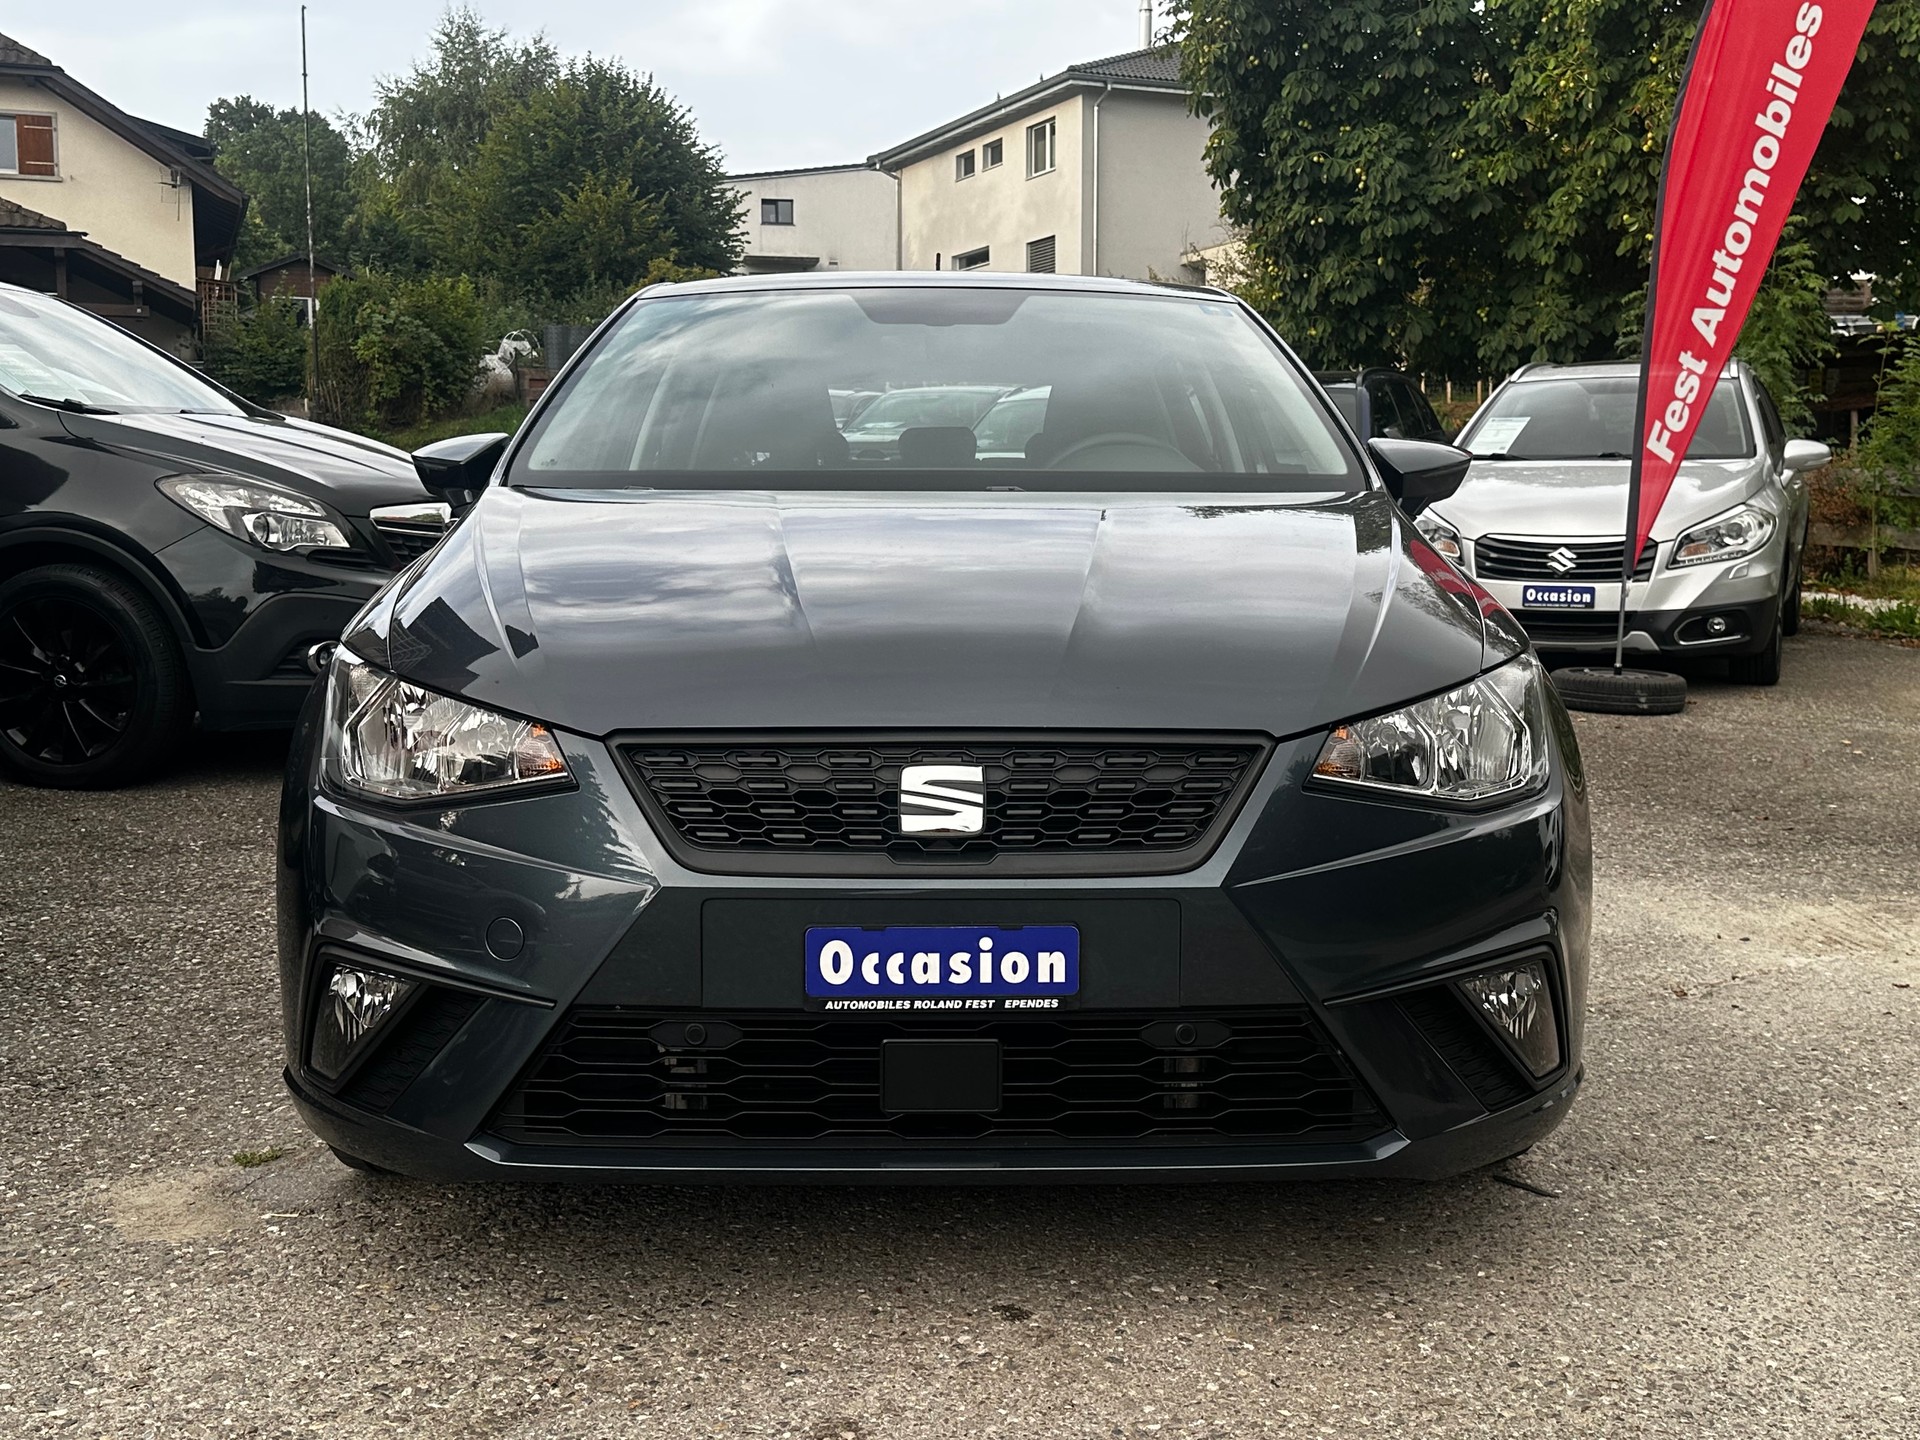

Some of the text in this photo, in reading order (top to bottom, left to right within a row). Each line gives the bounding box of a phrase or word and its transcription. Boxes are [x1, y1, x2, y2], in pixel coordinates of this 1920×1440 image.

[1646, 3, 1824, 464] Fest Automobiles
[1526, 588, 1591, 603] Occasion
[819, 936, 1066, 985] Occasion
[825, 999, 1059, 1010] AUTOMOBILES ROLAND FEST EPENDES
